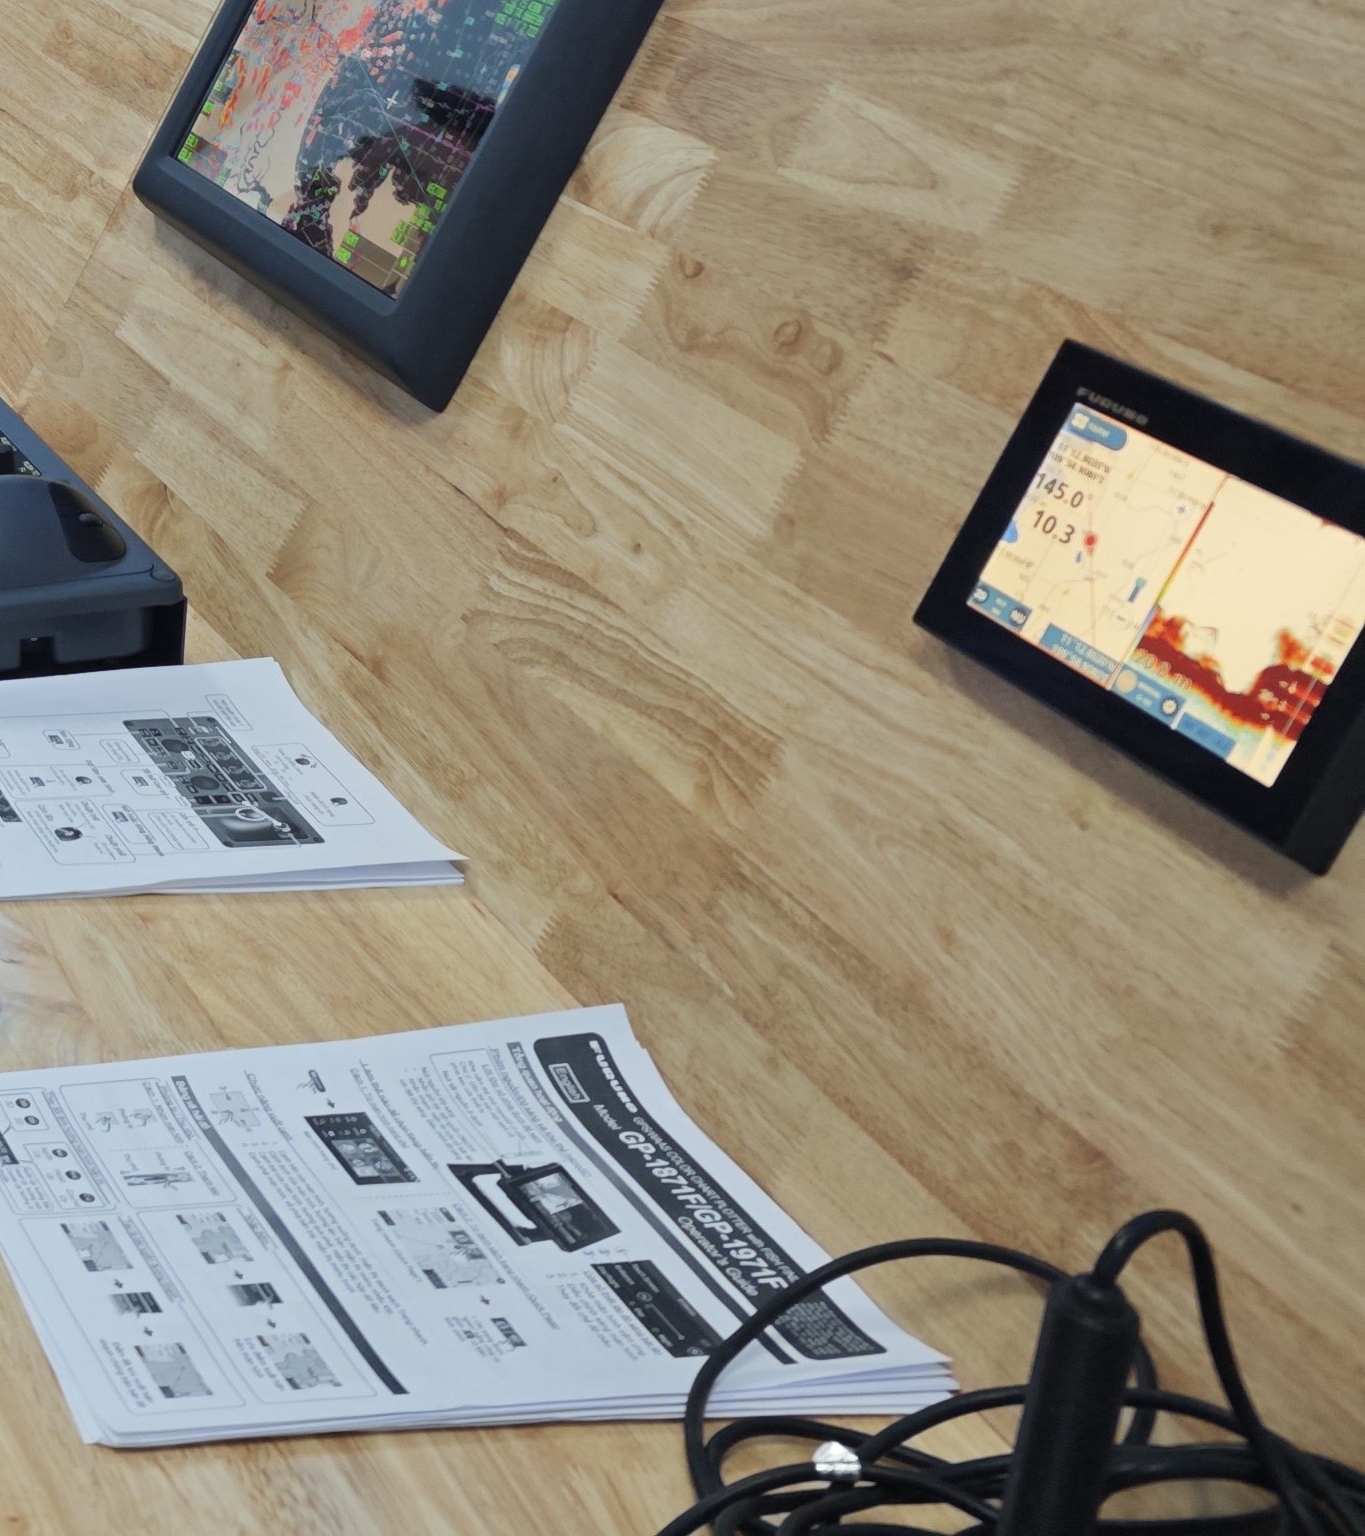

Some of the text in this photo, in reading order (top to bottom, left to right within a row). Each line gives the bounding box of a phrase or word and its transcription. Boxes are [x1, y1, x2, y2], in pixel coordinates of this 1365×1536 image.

[1076, 386, 1149, 426] FURUNO
[1035, 472, 1084, 508] 145.0
[1033, 510, 1075, 544] 10.3
[555, 1067, 580, 1101] English
[589, 1040, 638, 1113] FURUNO
[593, 1104, 622, 1130] Model
[619, 1131, 789, 1289] GP-1871F/GP-1971F
[677, 1216, 758, 1296] Operator's Guide
